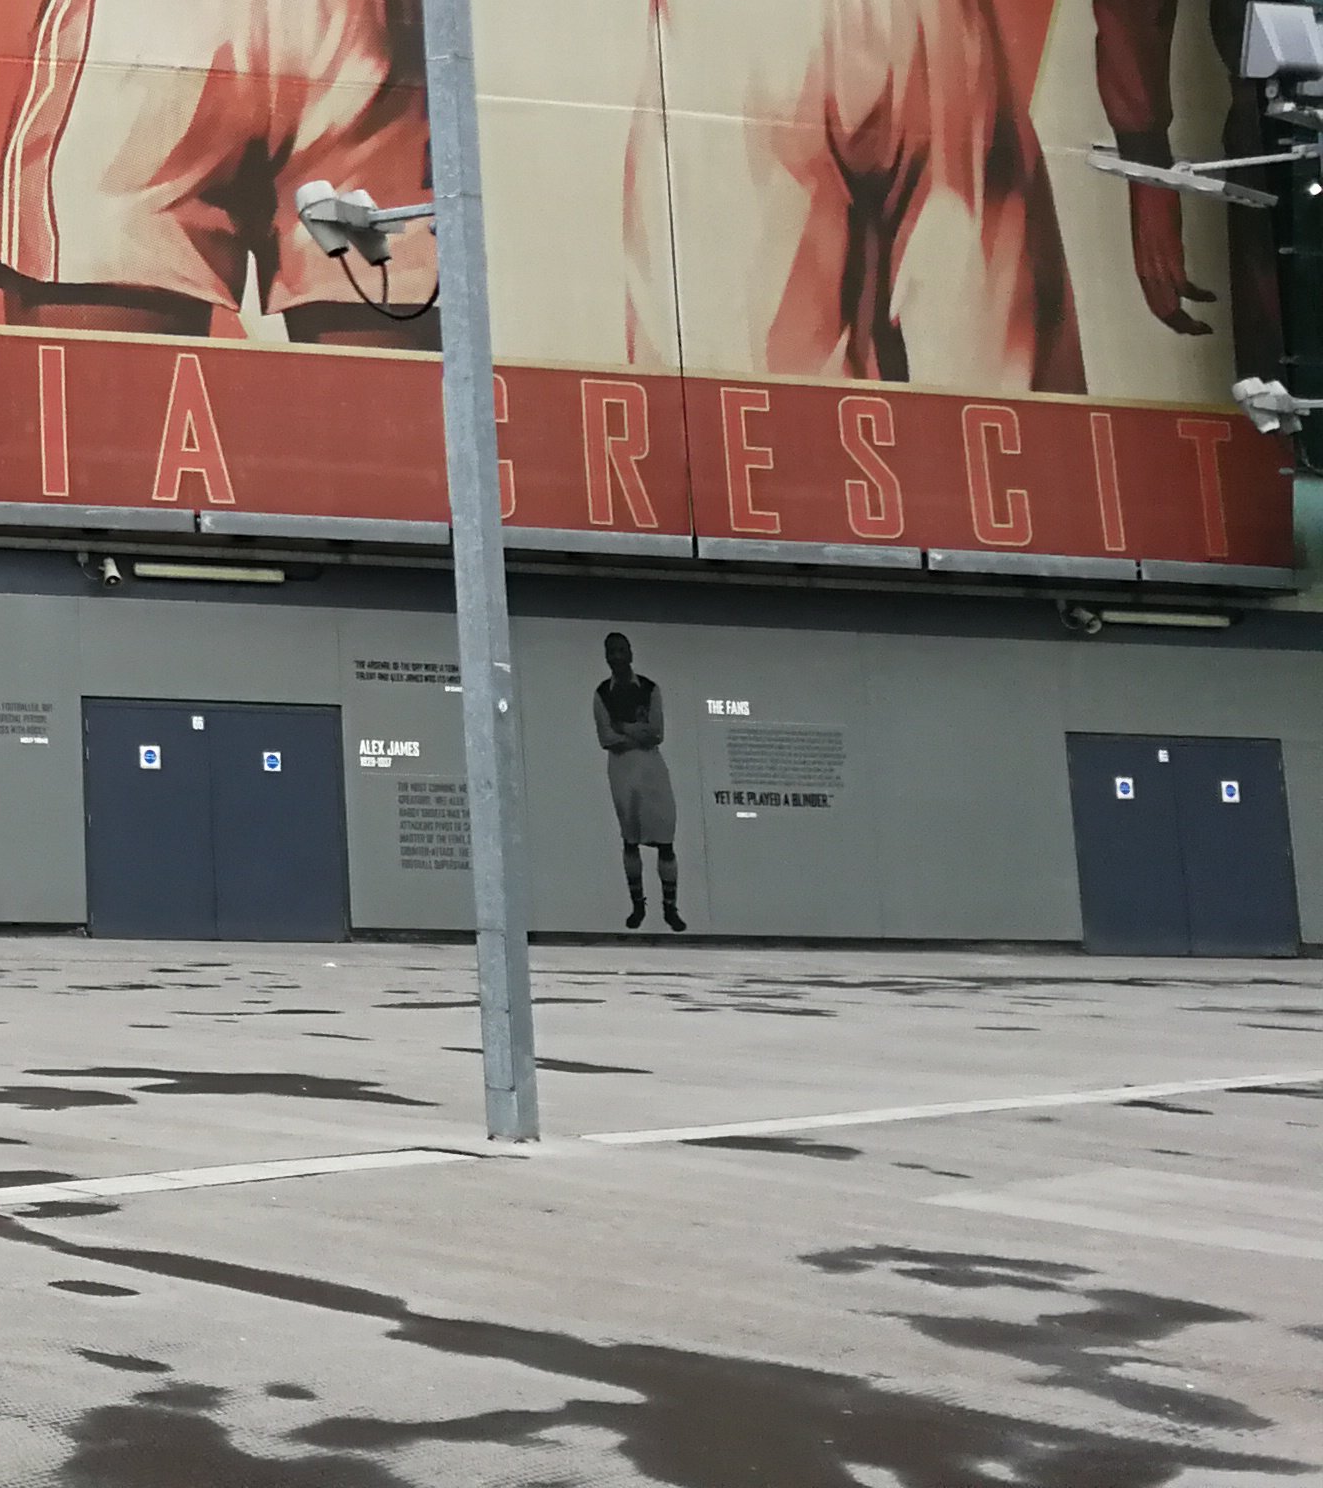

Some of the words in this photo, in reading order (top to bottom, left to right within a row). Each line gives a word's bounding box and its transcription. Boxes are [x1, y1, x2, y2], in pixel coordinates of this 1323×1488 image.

[707, 700, 724, 714] THE
[725, 700, 750, 715] FANS
[360, 739, 384, 755] ALEX
[387, 740, 419, 756] JAMES
[714, 791, 730, 805] YET
[732, 791, 743, 805] HE
[747, 792, 781, 806] PLAYED
[783, 793, 790, 806] A
